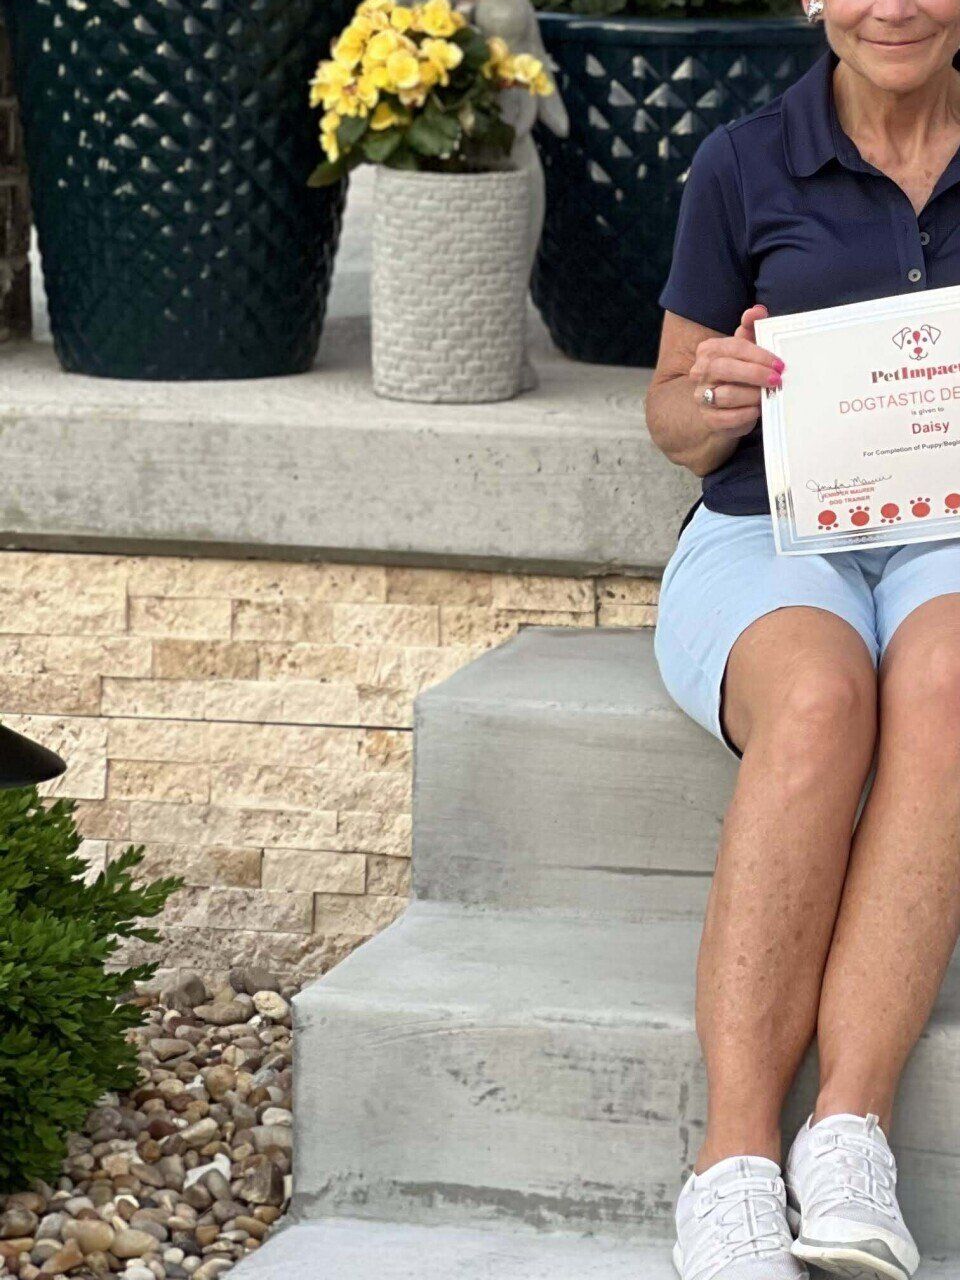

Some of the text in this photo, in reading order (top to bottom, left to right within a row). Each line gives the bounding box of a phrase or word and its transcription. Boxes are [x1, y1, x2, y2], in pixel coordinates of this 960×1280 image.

[839, 389, 936, 414] DOGTASTIC
[918, 407, 936, 417] given
[911, 421, 950, 435] Daisy
[875, 445, 913, 457] Completion
